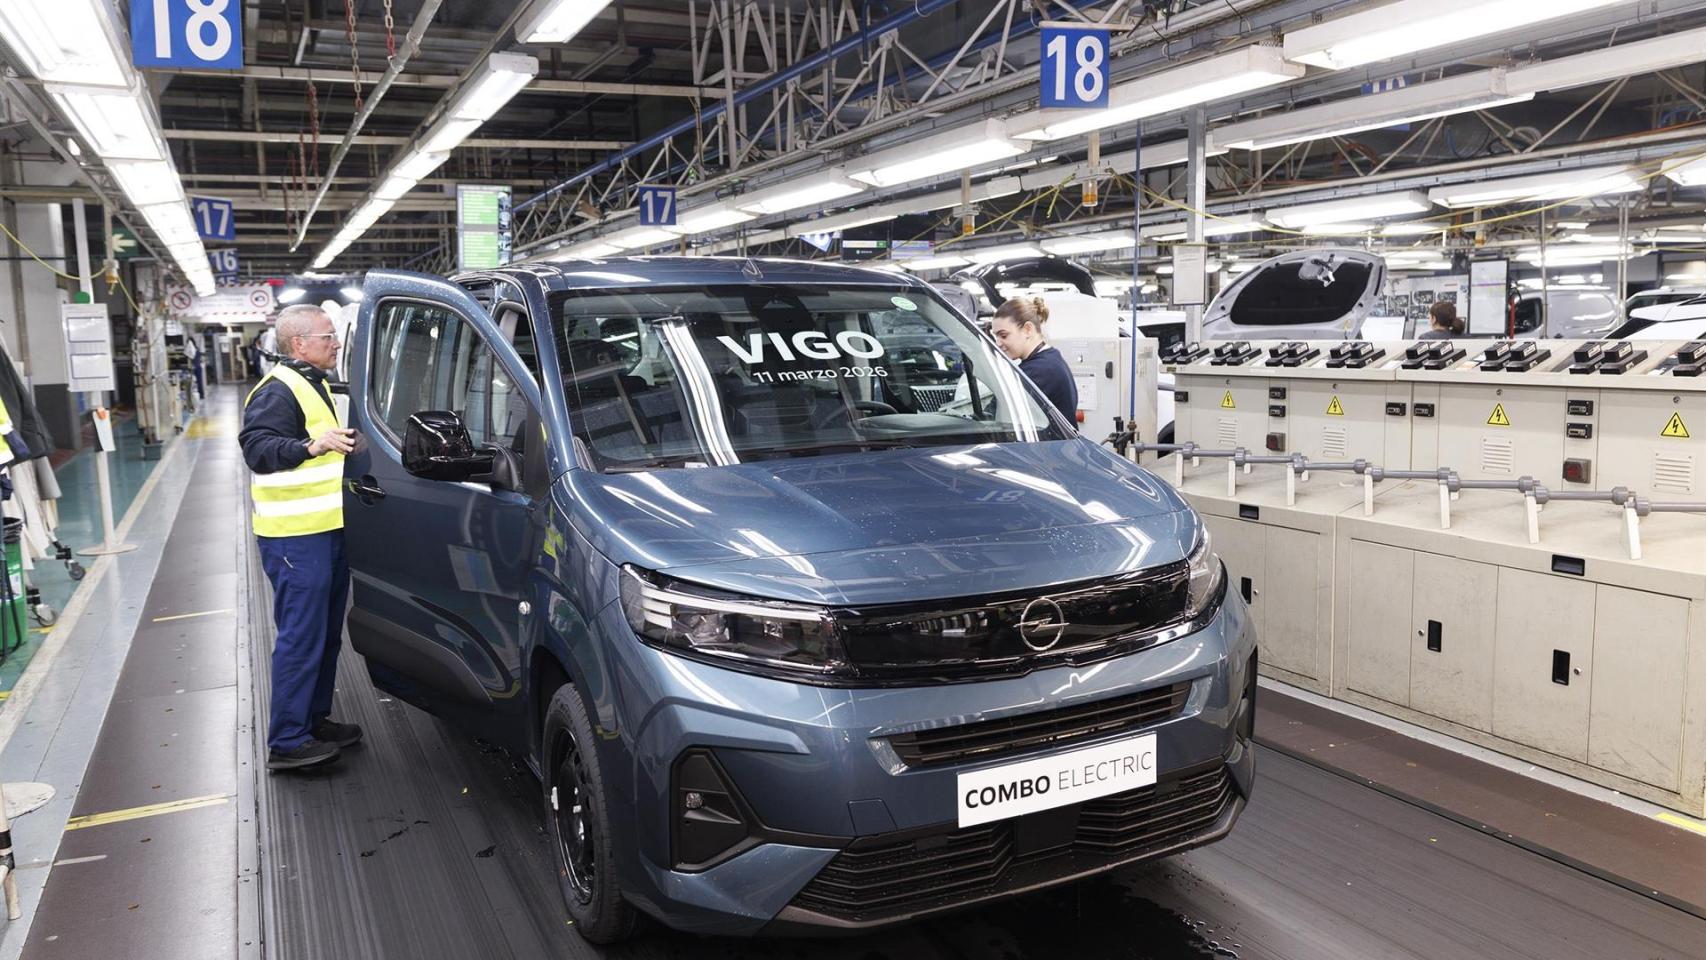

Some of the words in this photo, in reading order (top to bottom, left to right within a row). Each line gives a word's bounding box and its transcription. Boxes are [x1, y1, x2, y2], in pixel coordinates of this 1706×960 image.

[153, 0, 232, 61] 18
[1047, 35, 1104, 102] 18
[197, 201, 230, 236] 17
[642, 190, 672, 223] 17
[211, 249, 237, 271] 16
[716, 330, 885, 364] VIGO
[753, 371, 774, 384] 11
[778, 368, 837, 382] marzo
[840, 366, 888, 378] 2026
[965, 775, 1050, 808] COMBO
[1058, 751, 1152, 790] ELECTRIC
